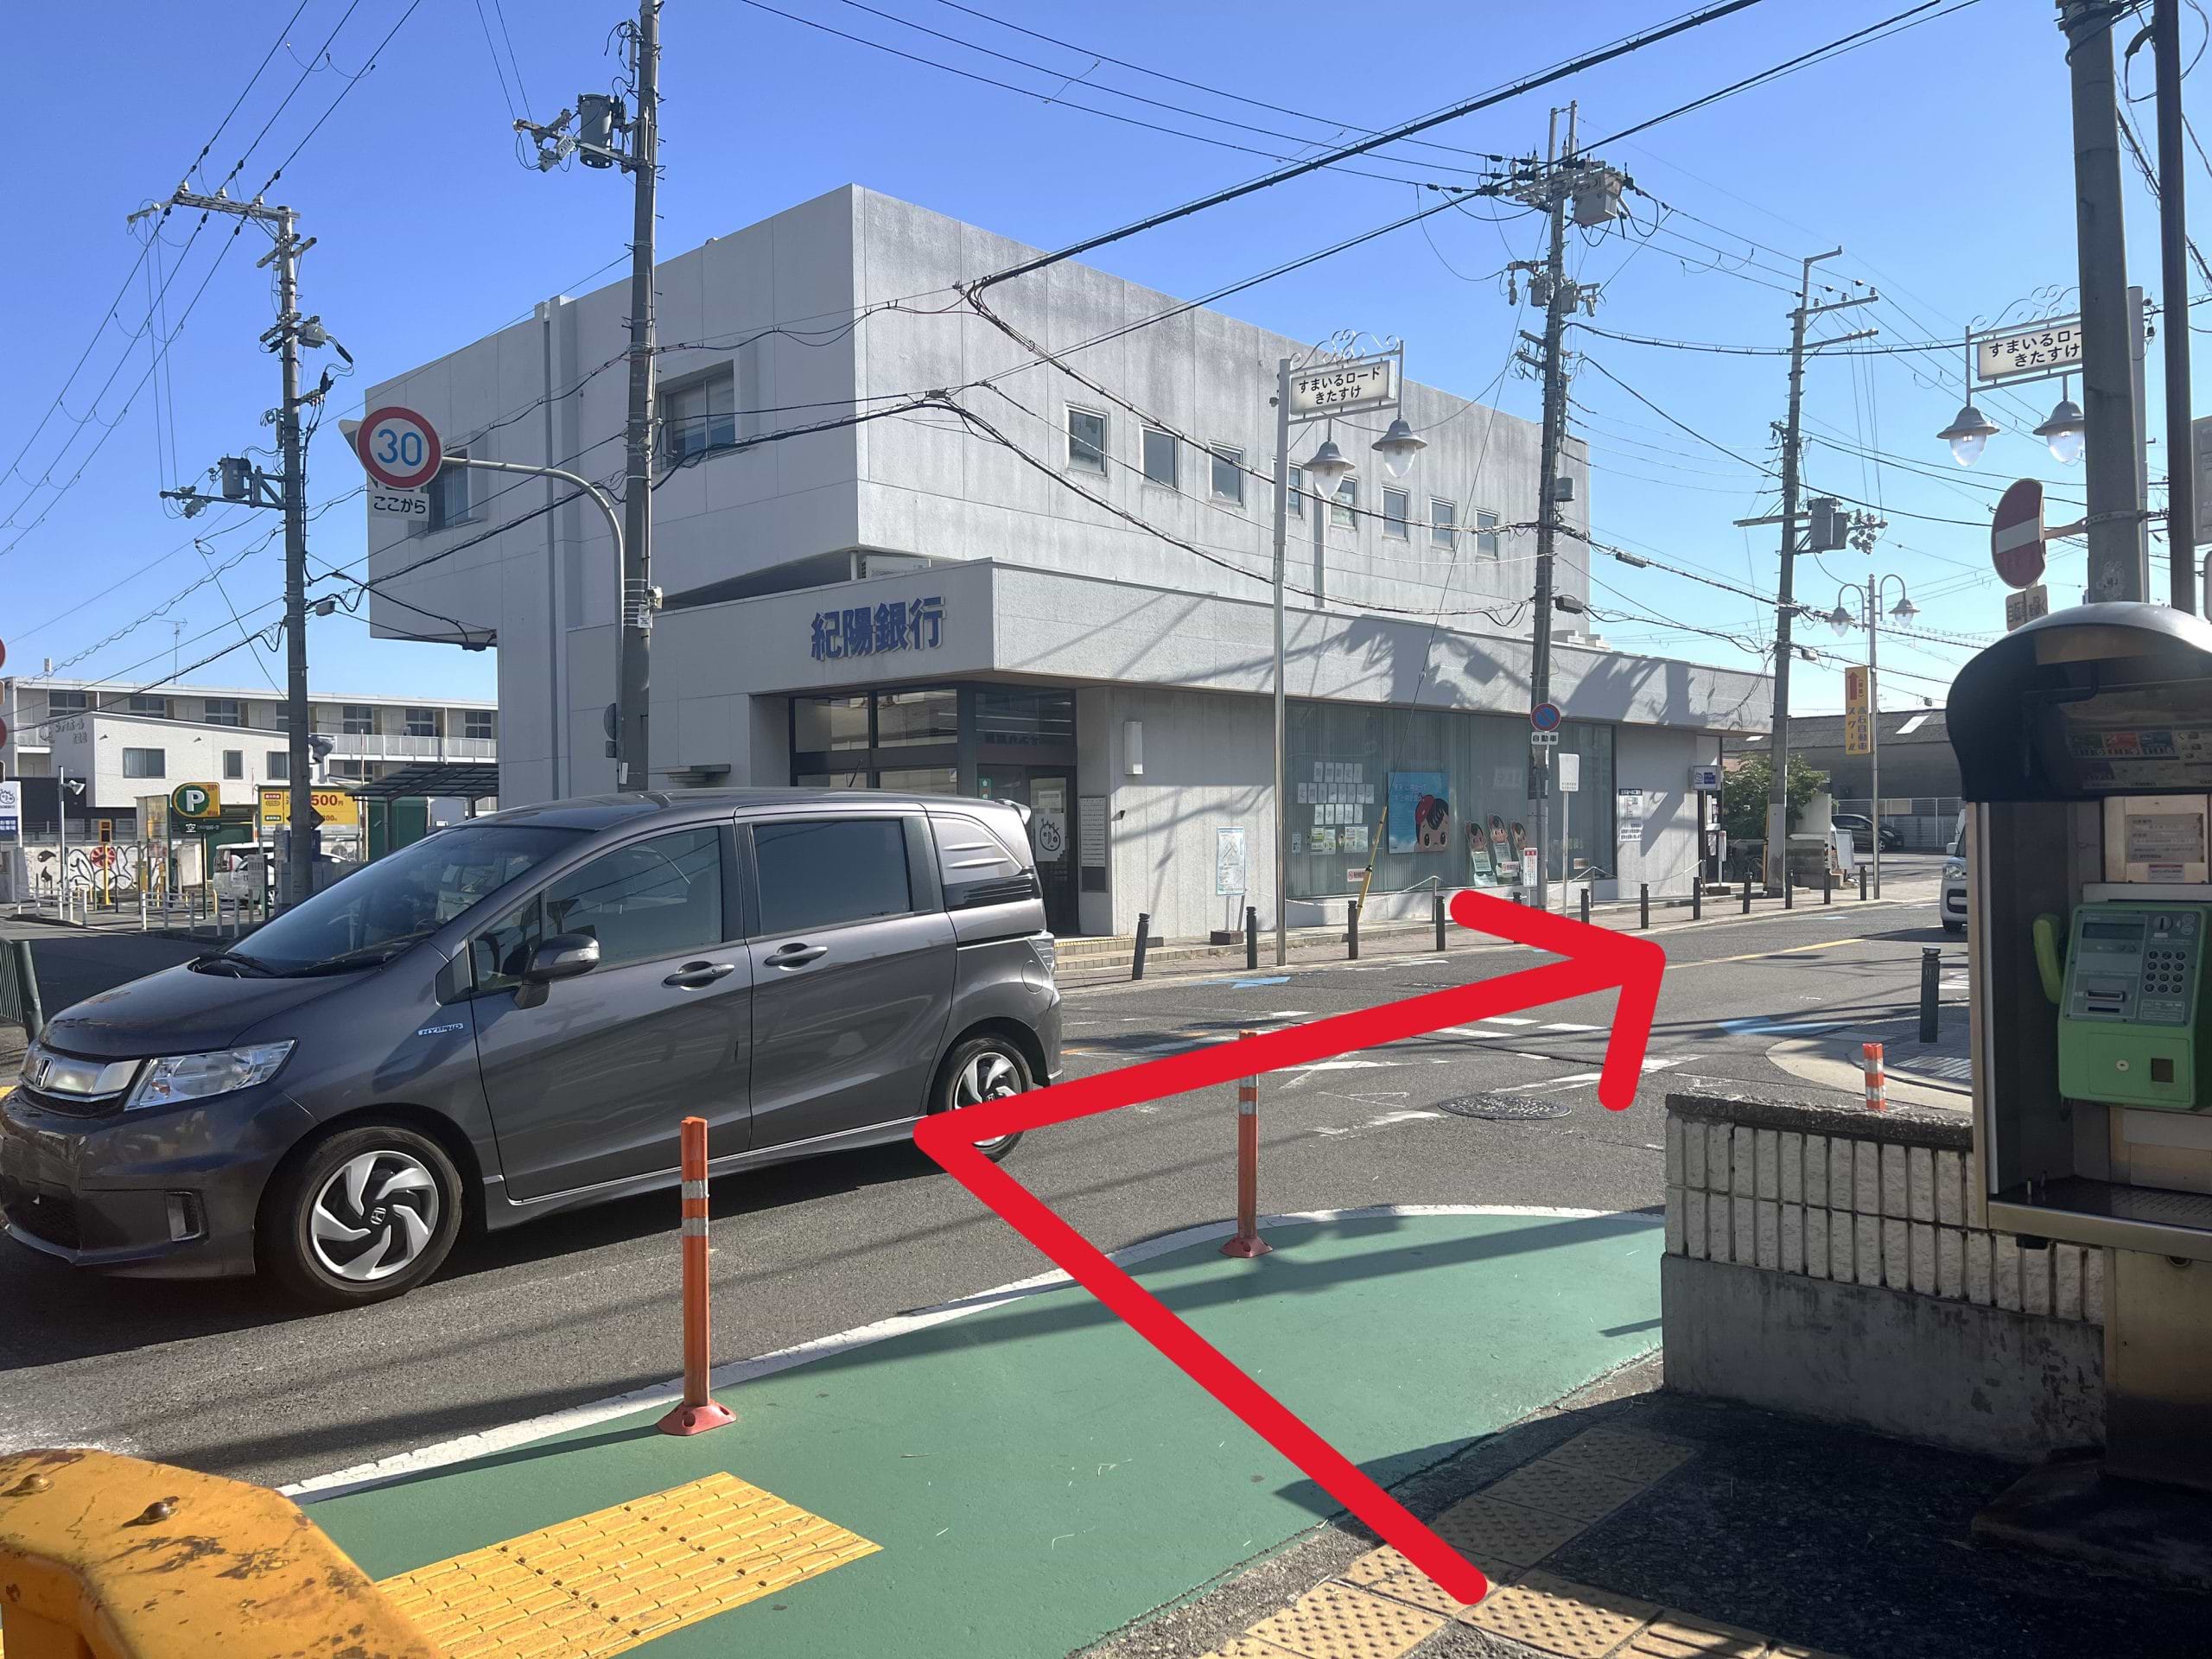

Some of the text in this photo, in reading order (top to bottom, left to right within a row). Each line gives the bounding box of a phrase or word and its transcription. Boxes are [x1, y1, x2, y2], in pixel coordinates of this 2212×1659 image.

[2015, 343, 2080, 367] きたすけ
[1299, 366, 1381, 393] すまいるロード
[1315, 385, 1362, 404] きたすけ
[378, 429, 422, 466] 30
[373, 495, 426, 514] ここから
[810, 596, 944, 661] 紀陽銀行
[1848, 707, 1857, 751] スクール
[186, 790, 205, 811] P
